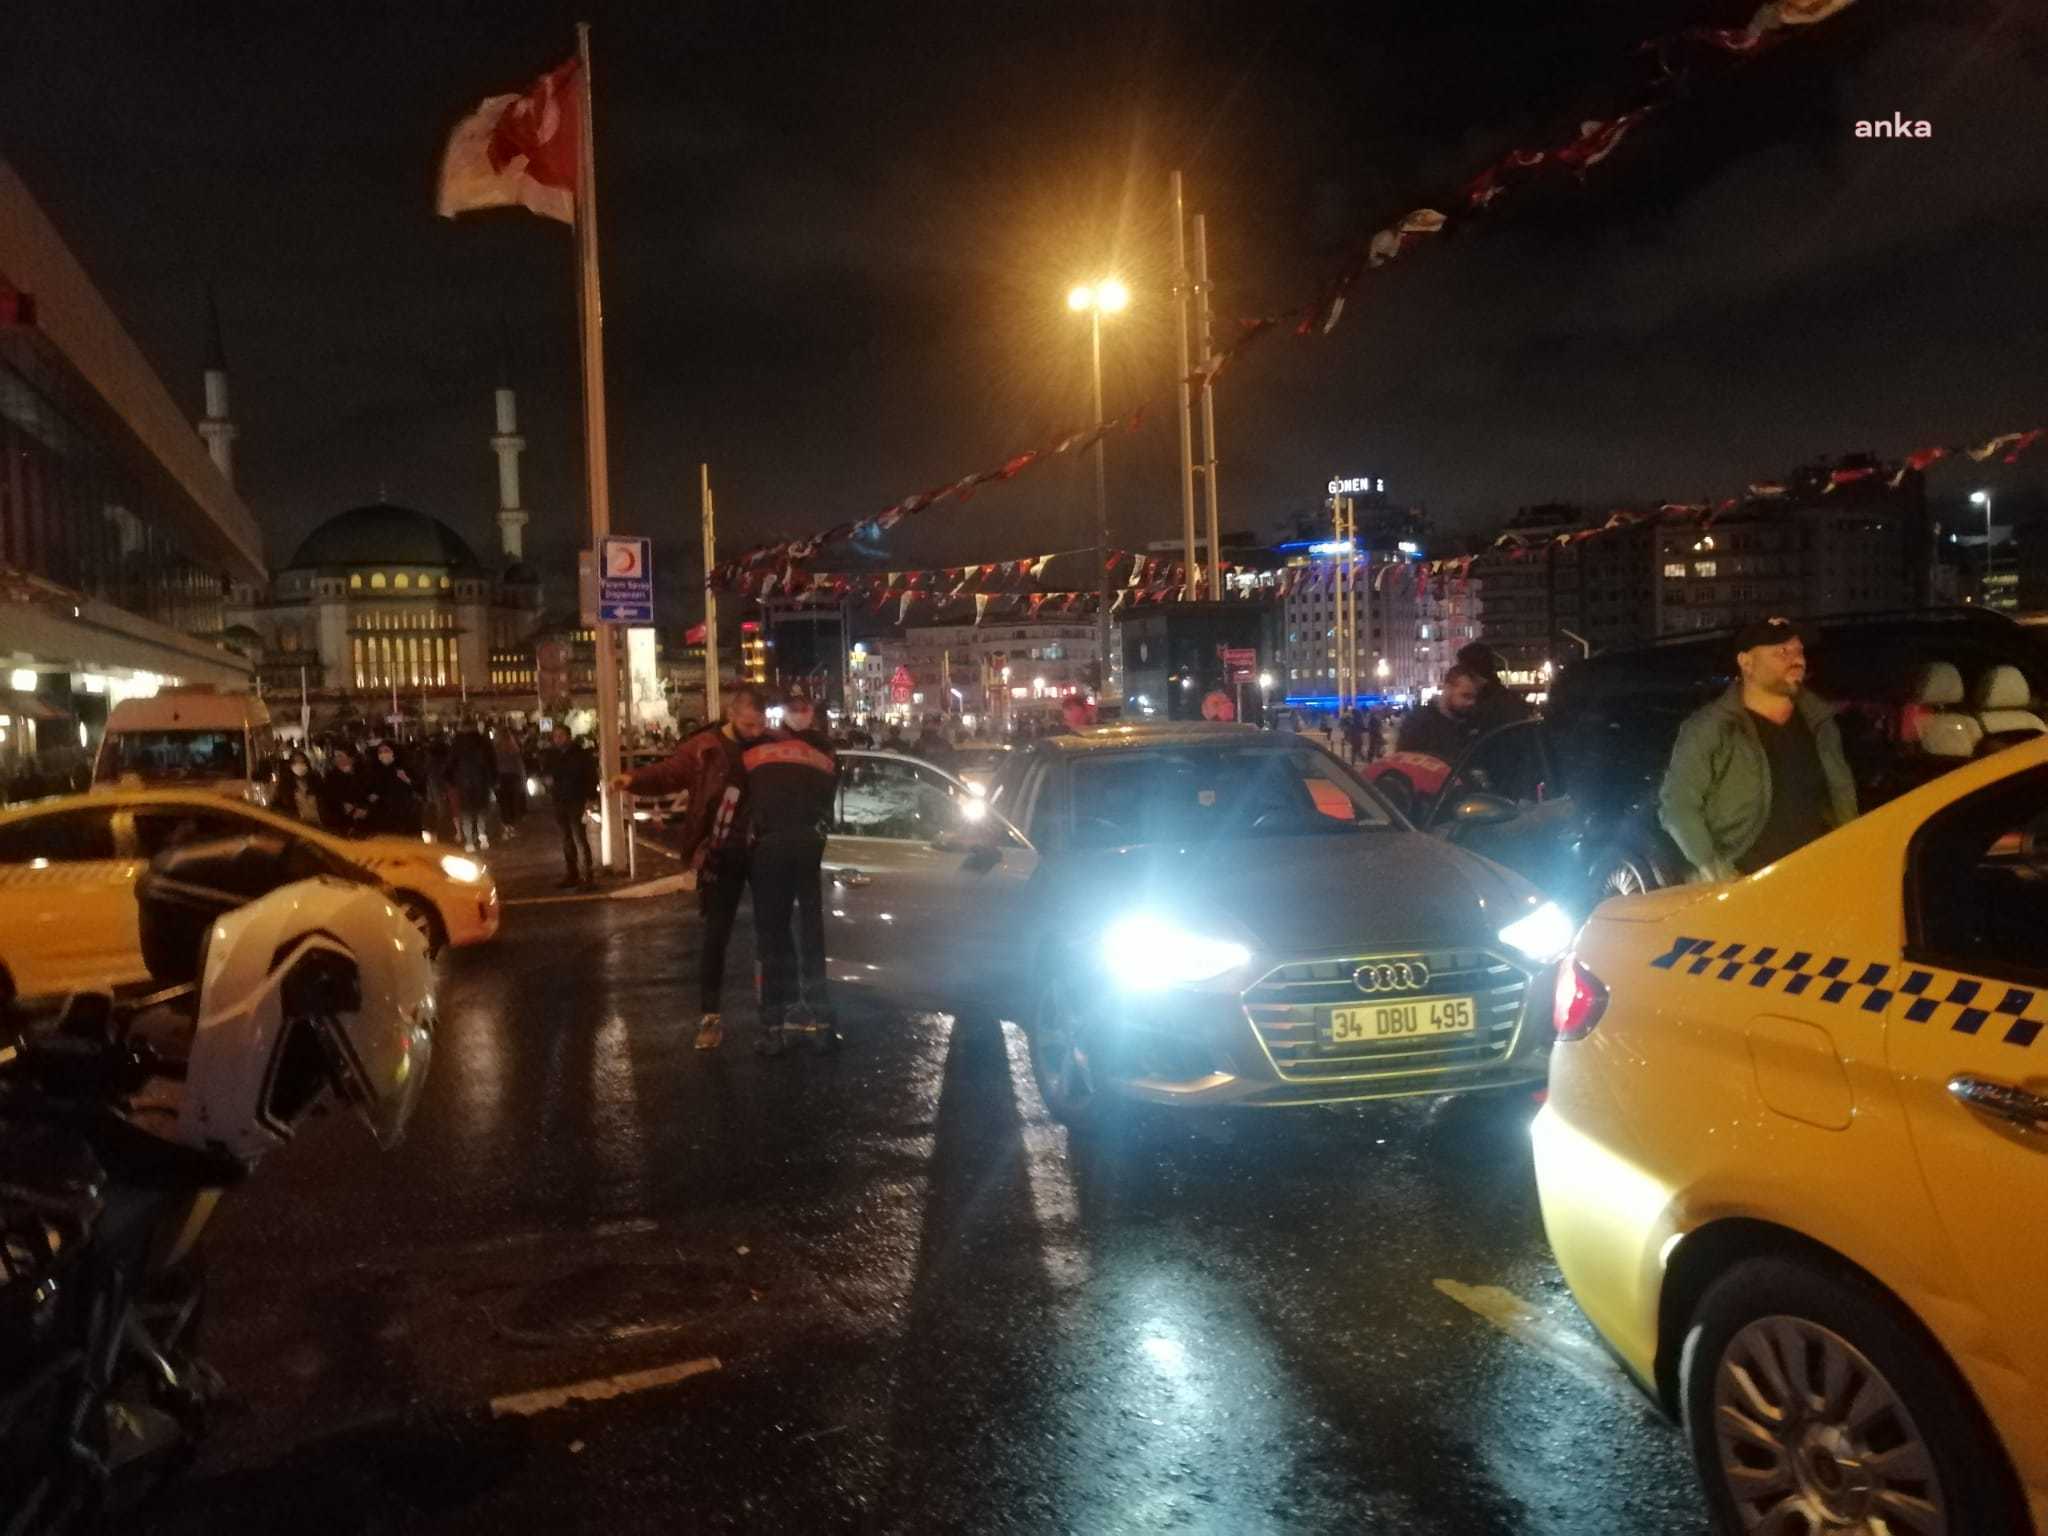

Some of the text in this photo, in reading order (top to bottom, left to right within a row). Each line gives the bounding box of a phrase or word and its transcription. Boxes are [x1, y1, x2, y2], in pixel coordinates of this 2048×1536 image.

[1335, 1011, 1362, 1039] 34
[1376, 1006, 1417, 1035] DBU
[1430, 1002, 1470, 1030] 495
